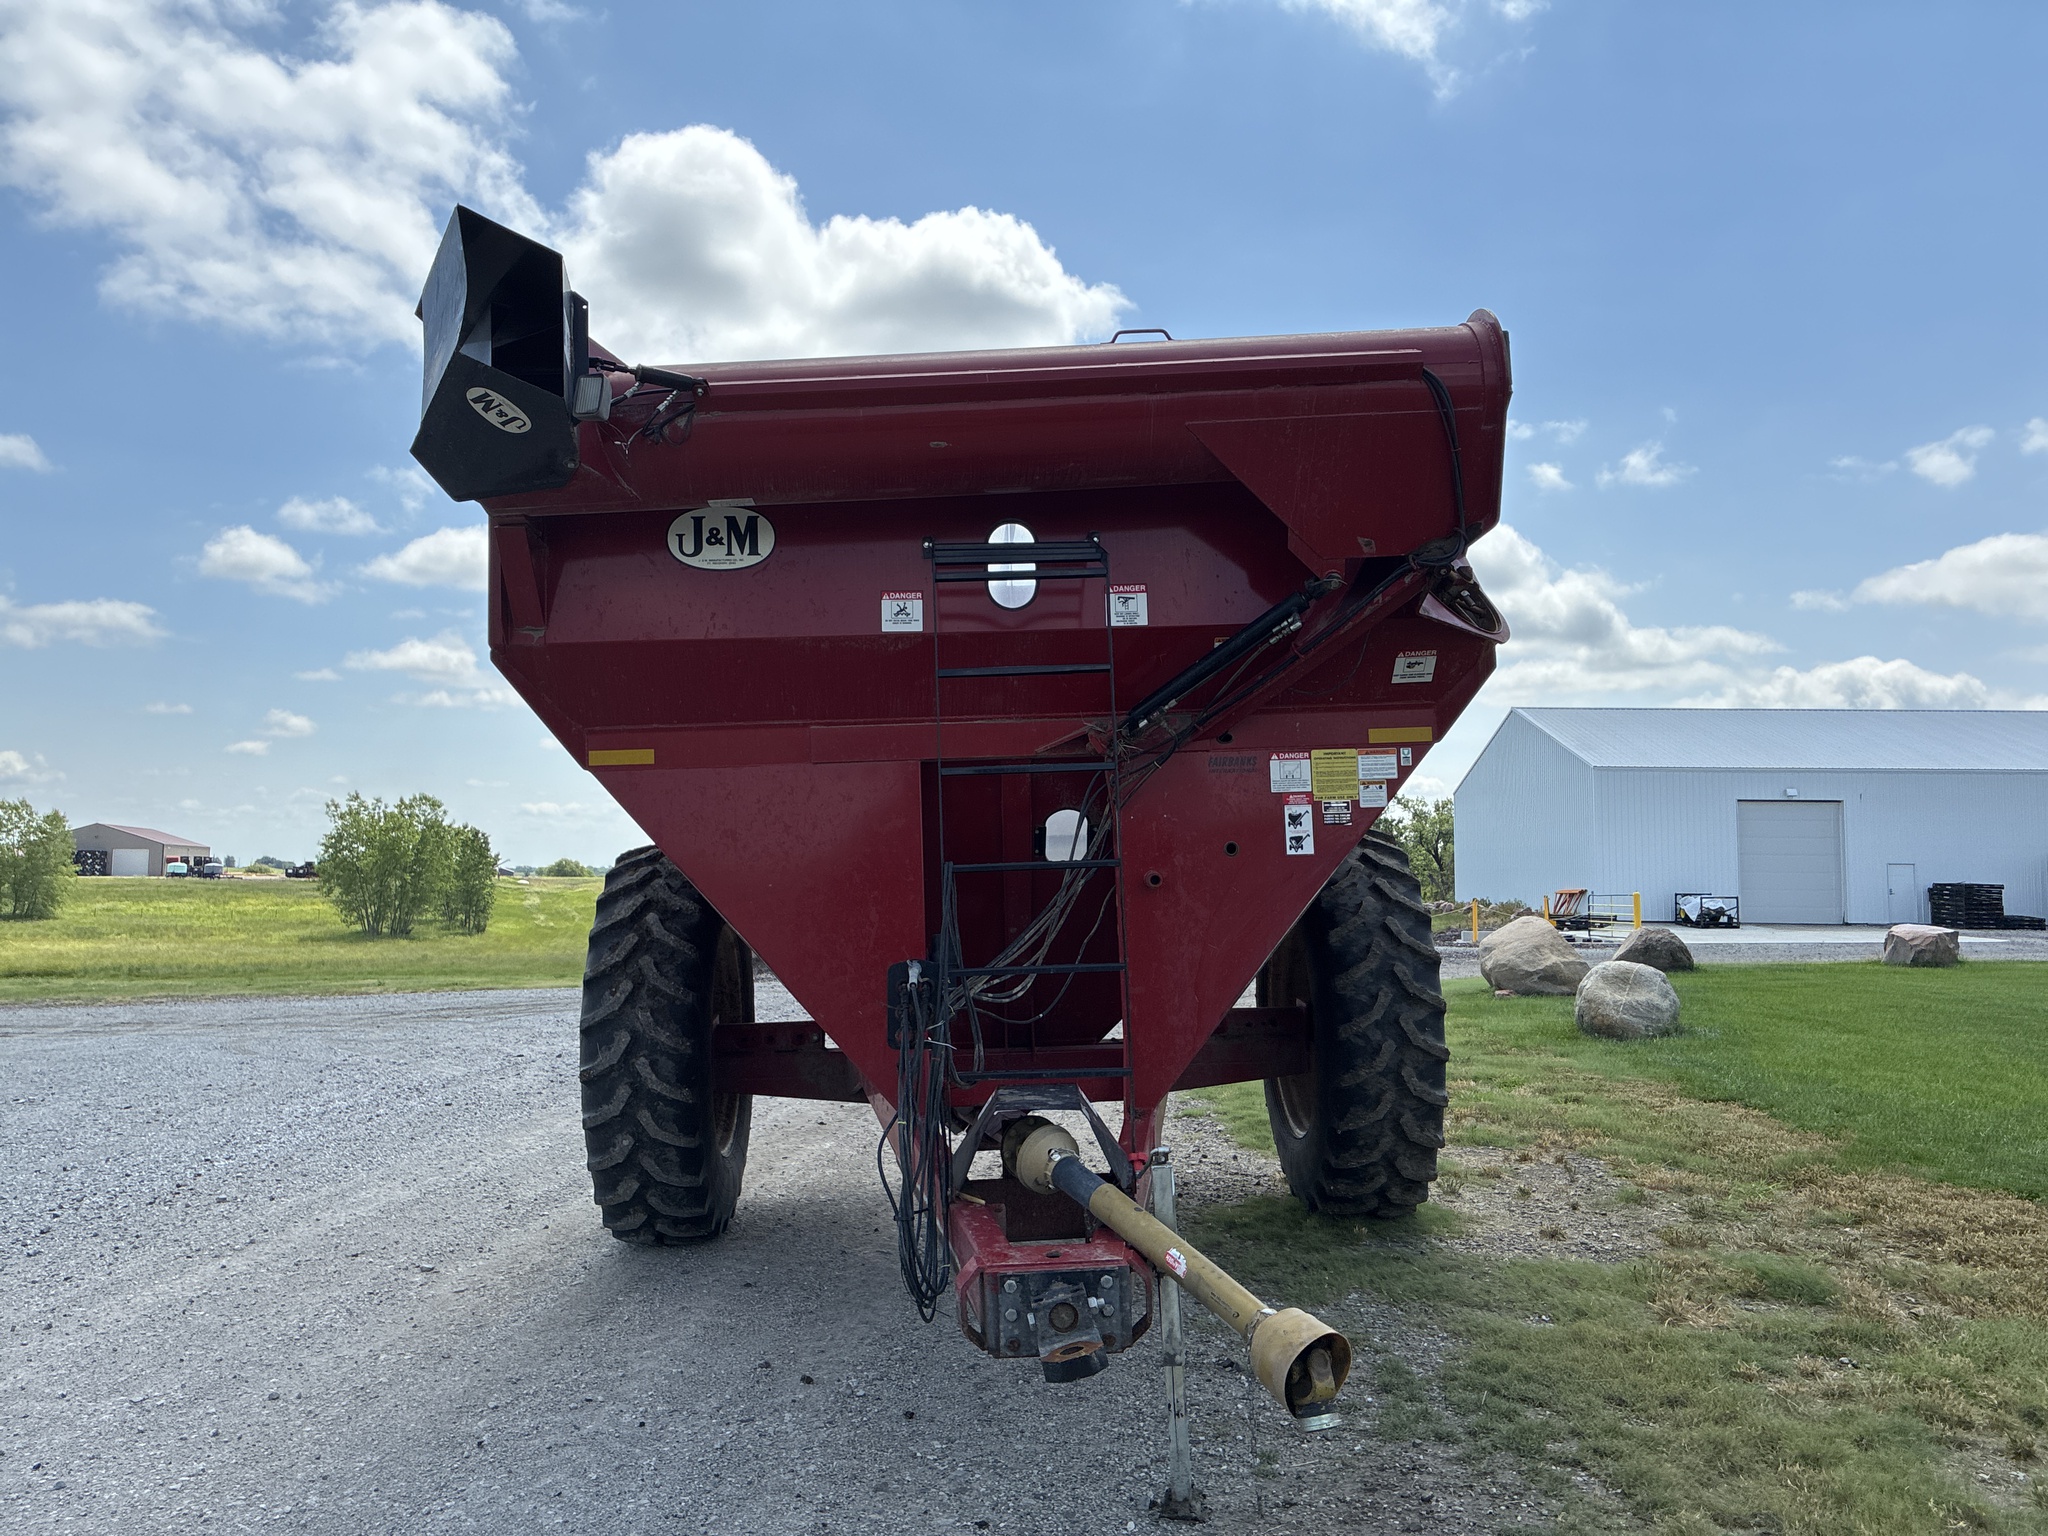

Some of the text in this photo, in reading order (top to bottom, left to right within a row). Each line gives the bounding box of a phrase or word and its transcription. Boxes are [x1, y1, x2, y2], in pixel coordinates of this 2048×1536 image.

[469, 390, 527, 430] J&M
[675, 515, 761, 557] J&M
[1113, 584, 1146, 592] DANGER
[1208, 755, 1257, 767] FAIRBANKS
